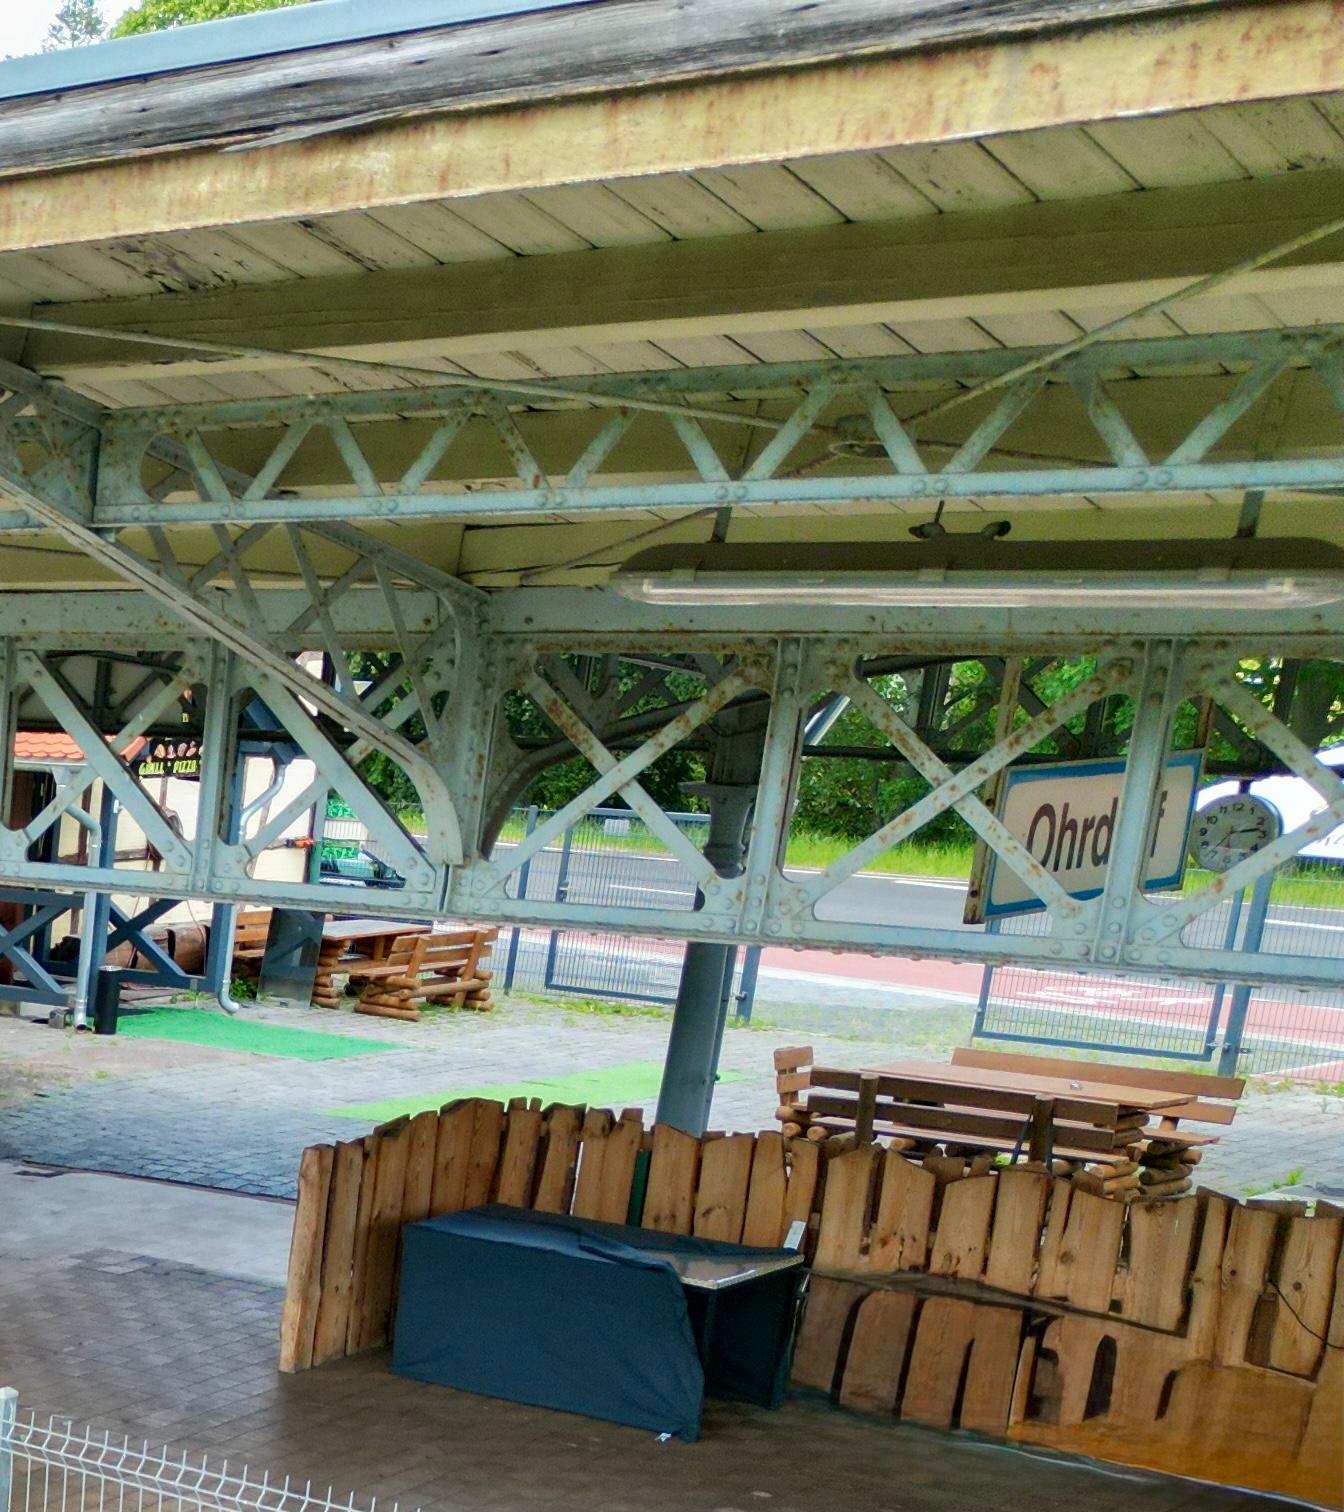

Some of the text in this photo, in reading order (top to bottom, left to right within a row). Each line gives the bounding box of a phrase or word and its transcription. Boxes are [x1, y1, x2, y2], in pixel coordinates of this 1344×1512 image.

[1219, 806, 1228, 814] 11
[1232, 803, 1245, 812] 12
[1206, 815, 1218, 825] 10
[1256, 817, 1265, 825] 2
[1026, 790, 1168, 872] Ohrdf
[1199, 828, 1208, 837] 9
[1258, 830, 1266, 839] 3
